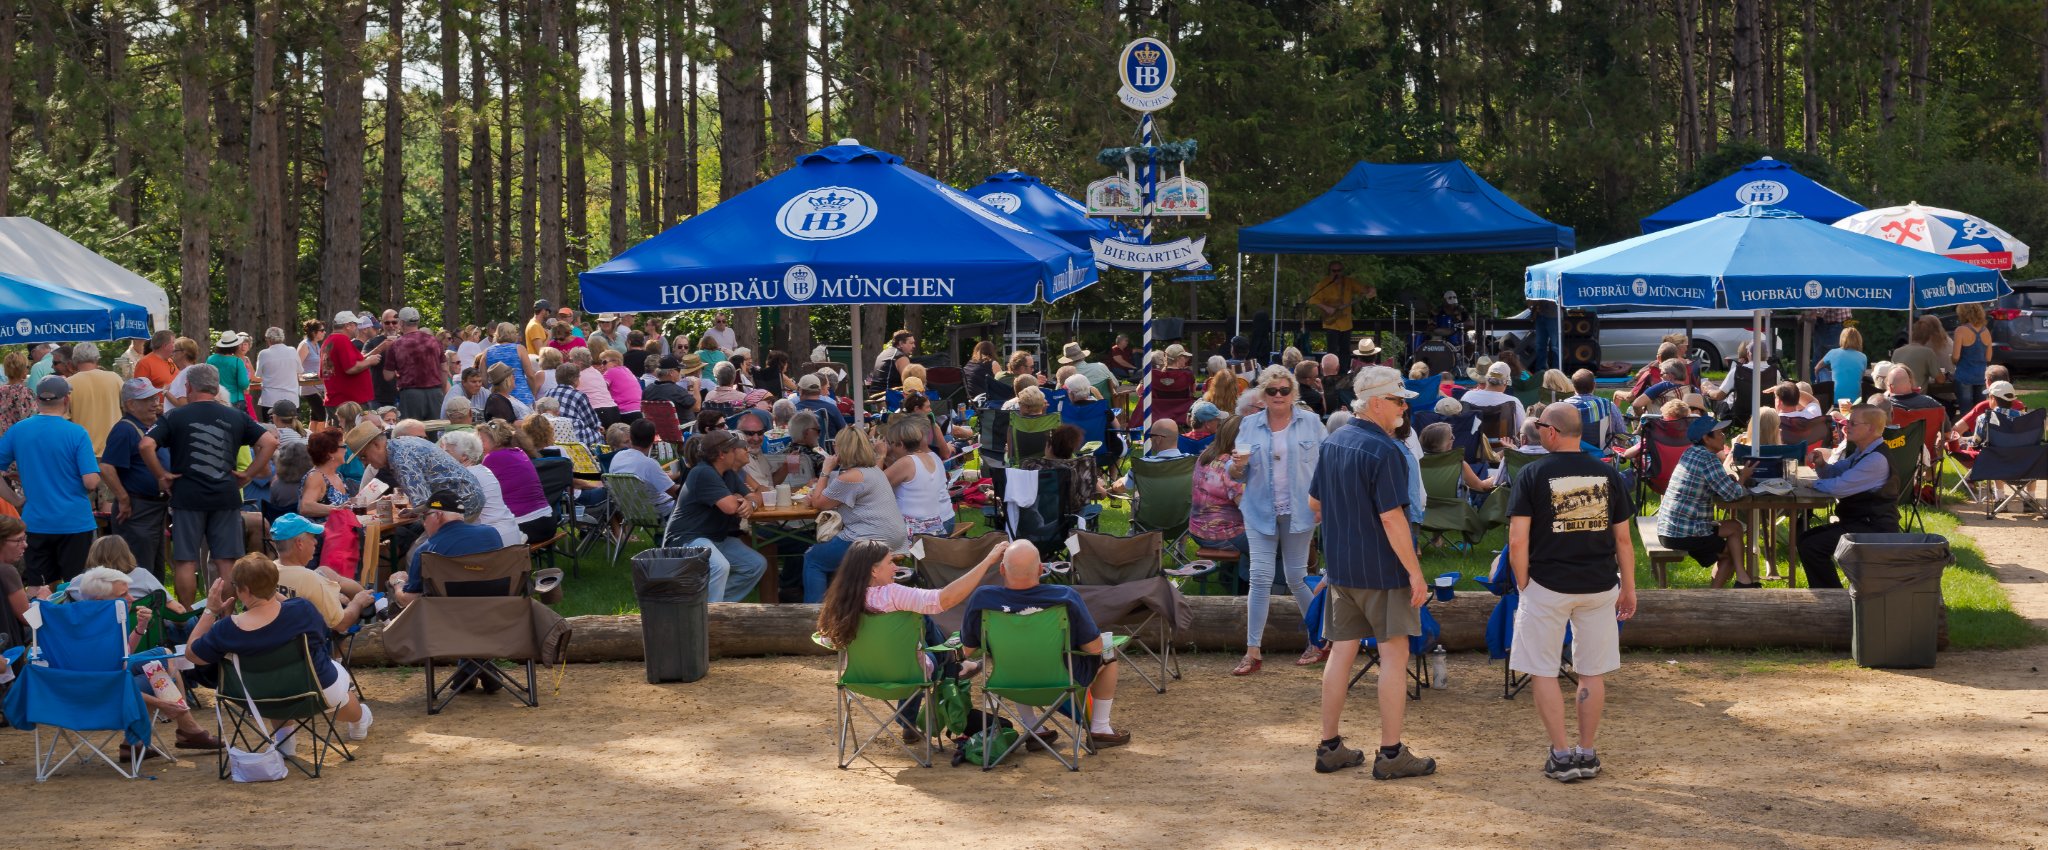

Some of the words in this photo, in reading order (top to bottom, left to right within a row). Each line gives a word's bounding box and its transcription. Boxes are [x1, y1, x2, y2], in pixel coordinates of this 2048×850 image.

[1134, 66, 1160, 86] HB
[1124, 92, 1170, 108] MÜNCHEN
[799, 212, 847, 231] HB
[1103, 245, 1193, 263] BIERGARTEN
[660, 278, 780, 304] HOFBRÄU
[793, 282, 809, 295] HB
[821, 275, 955, 298] MÜNCHEN
[1578, 285, 1630, 298] HOFBRÄU
[1649, 285, 1706, 299] MÜNCHEN
[1741, 286, 1802, 301] HOFBRÄU
[1824, 285, 1893, 299] MÜNCHEN
[1956, 282, 1994, 295] MÜNCHEN
[34, 323, 95, 335] MÜNCHEN
[1883, 435, 1906, 449] KERS
